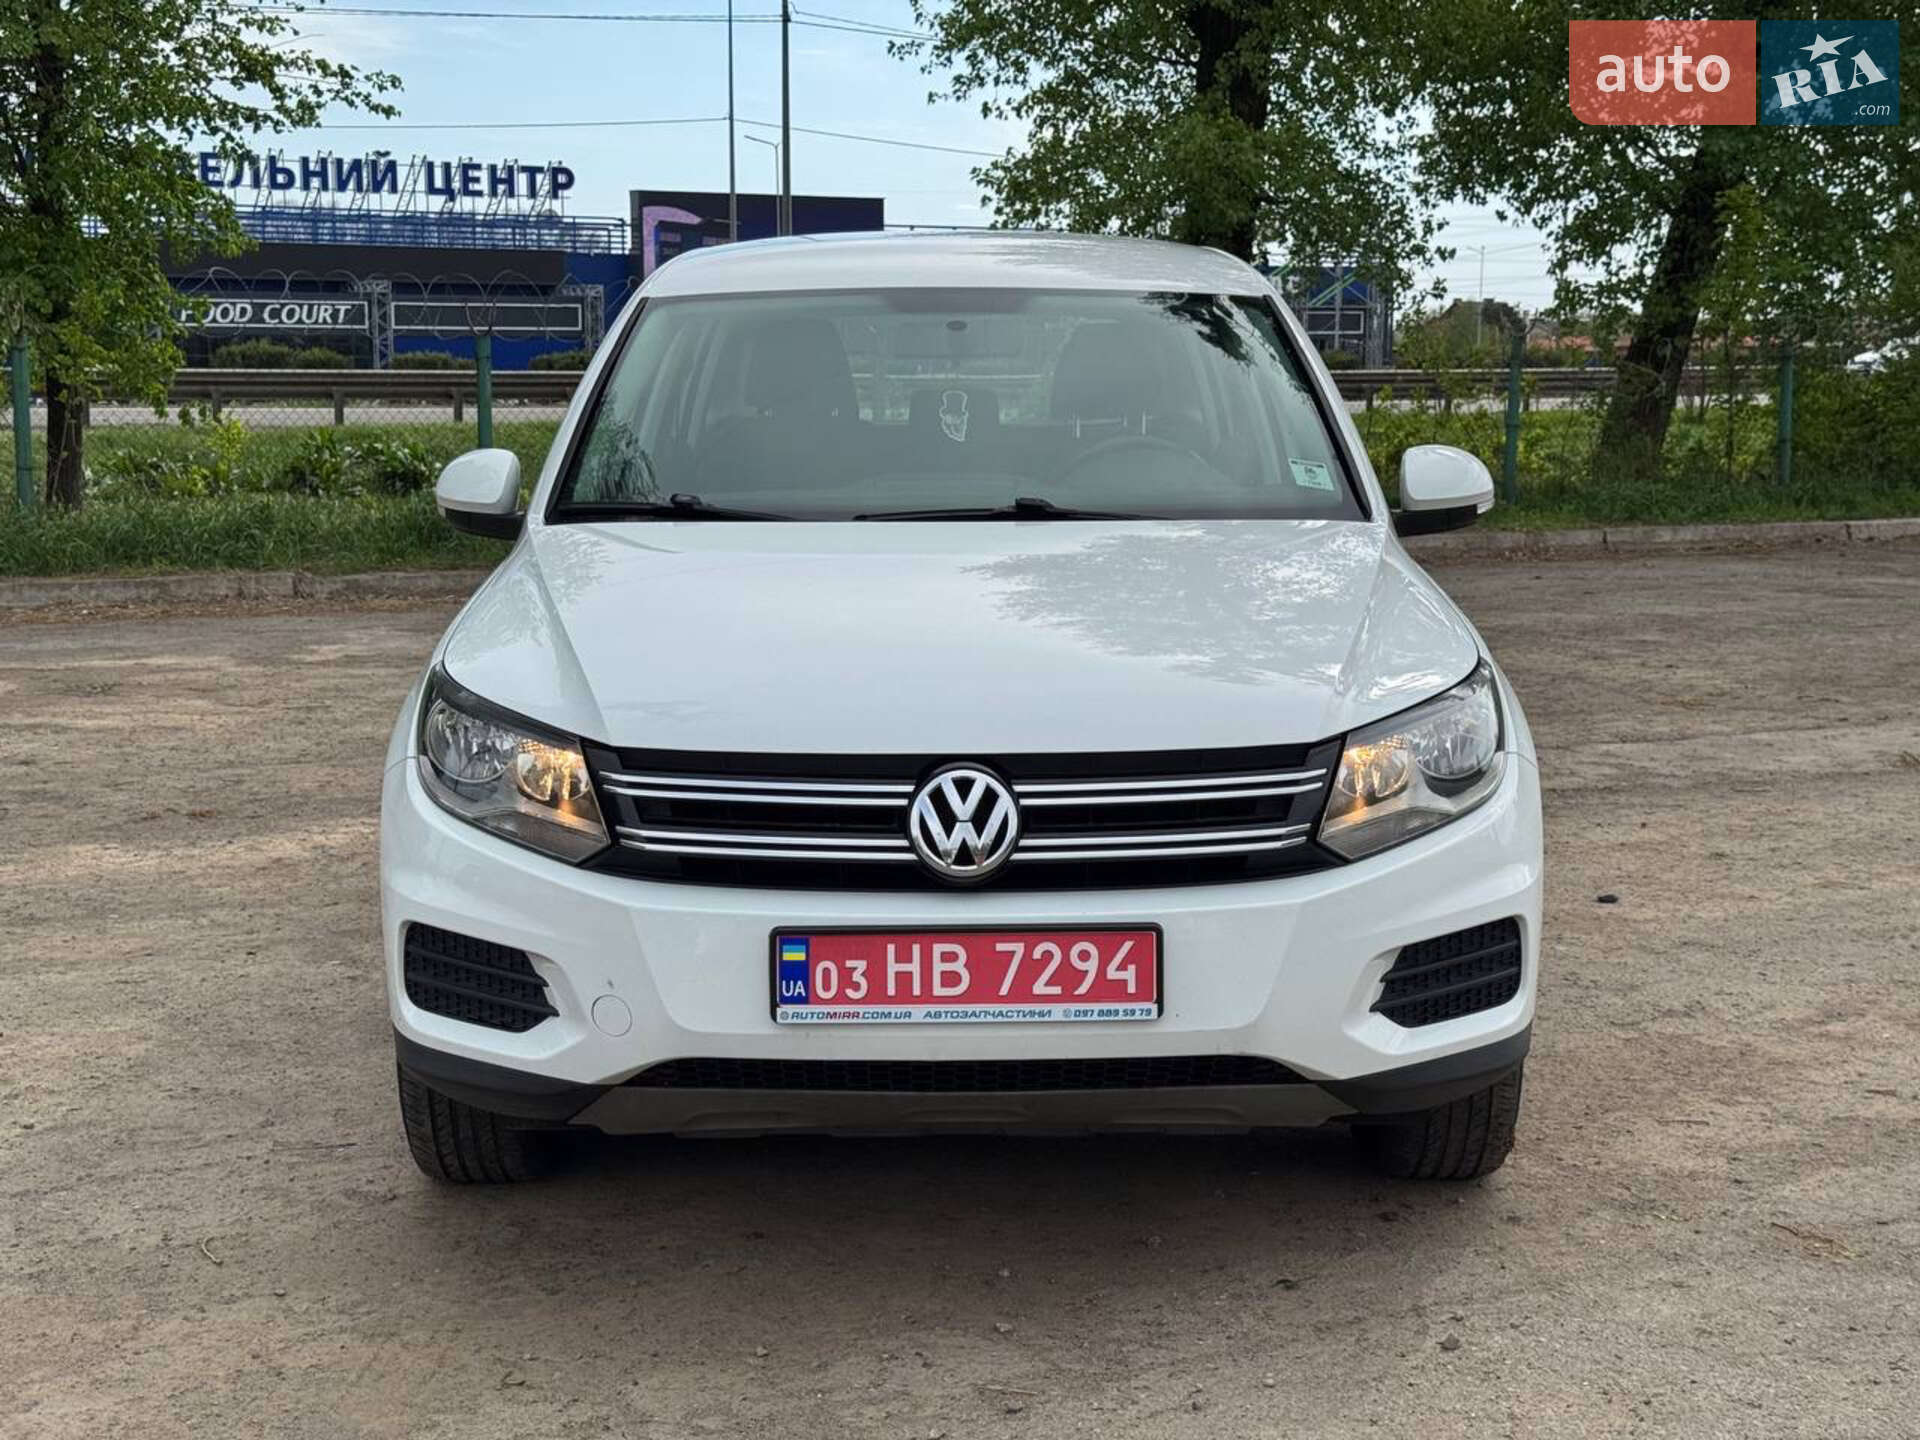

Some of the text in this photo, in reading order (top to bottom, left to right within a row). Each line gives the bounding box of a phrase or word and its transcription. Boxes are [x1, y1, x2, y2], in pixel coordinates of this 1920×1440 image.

[200, 150, 575, 203] ЕЛЬНИЙ ЦЕНТР
[263, 303, 352, 325] COURT
[782, 940, 1137, 1000] UA 03 HB 7294
[923, 1009, 1052, 1020] АВТОЗАПЧАСТИНИ
